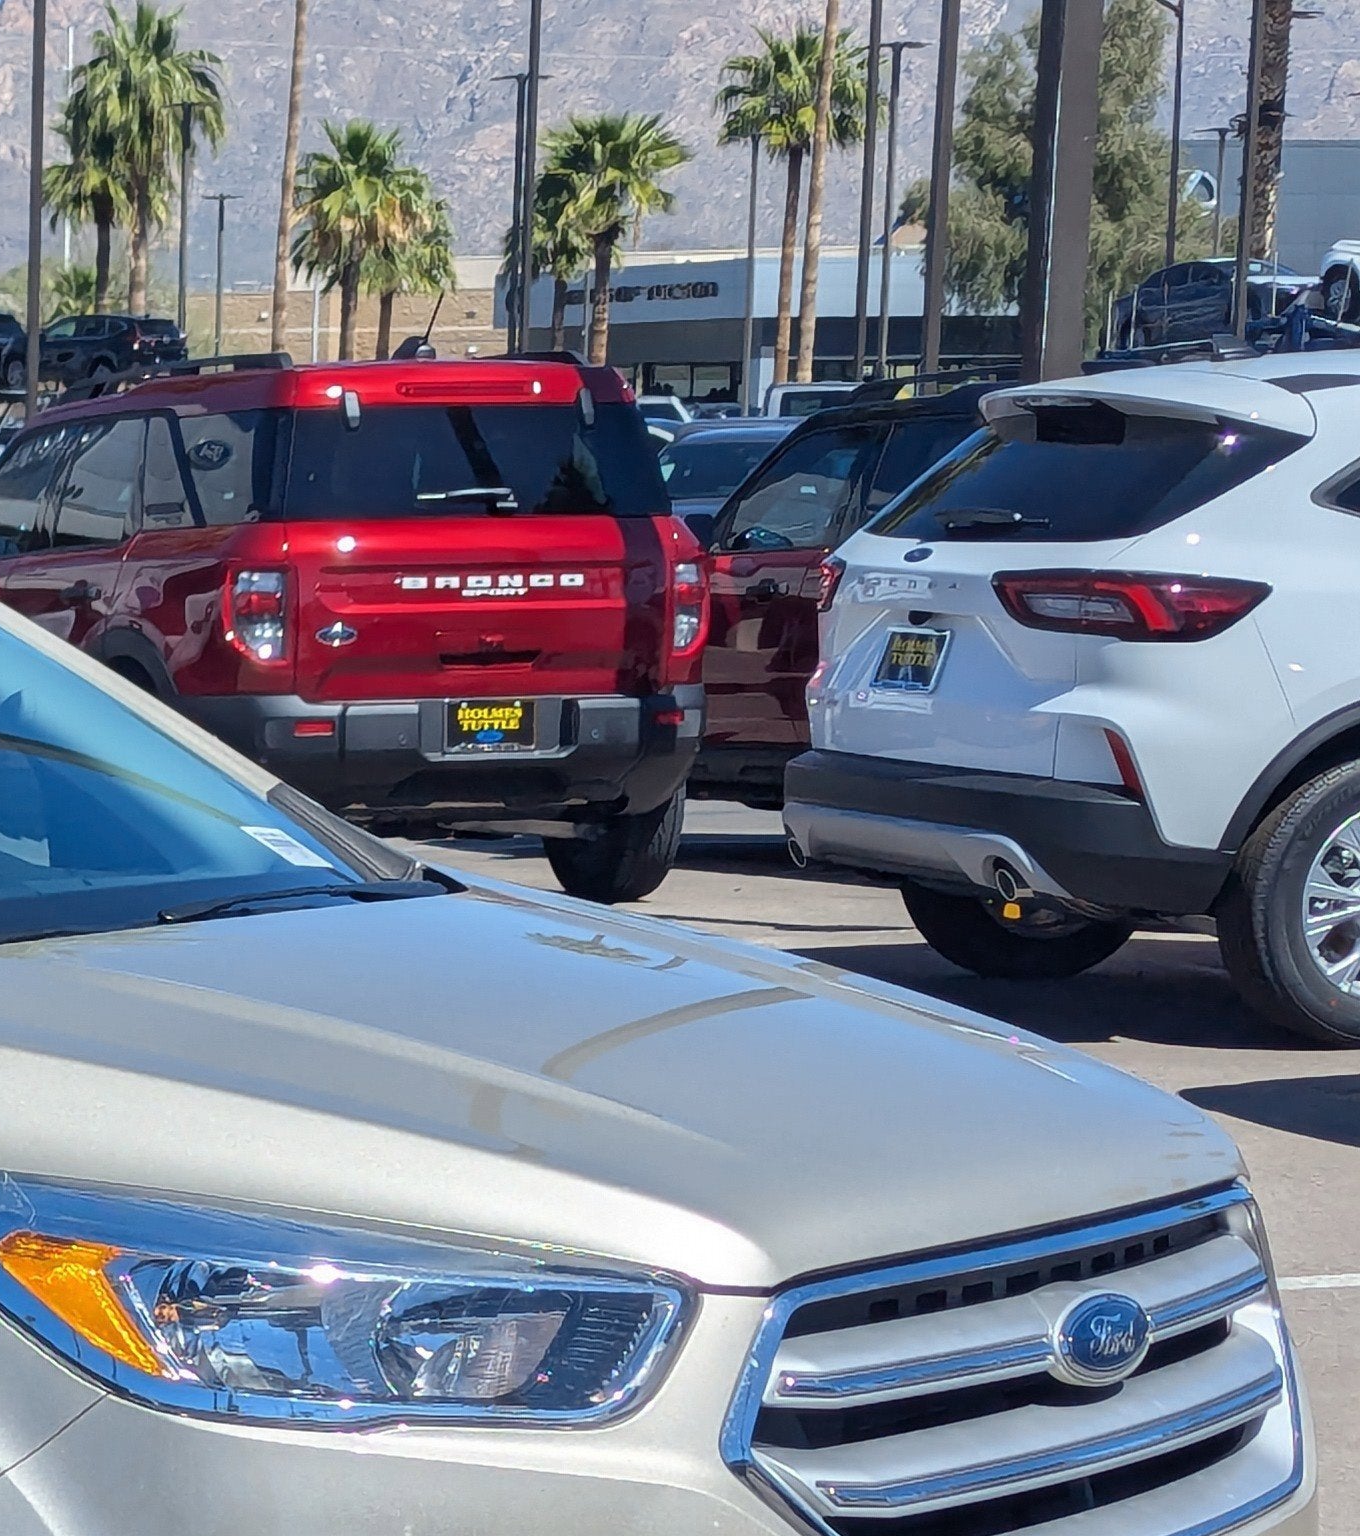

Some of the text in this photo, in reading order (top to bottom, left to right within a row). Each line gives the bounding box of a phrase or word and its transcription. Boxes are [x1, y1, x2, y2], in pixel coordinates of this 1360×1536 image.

[401, 573, 584, 590] BRONCO
[461, 588, 528, 597] SPORT
[457, 707, 523, 721] HOLMES
[459, 719, 520, 731] TUTTLE
[1089, 1313, 1136, 1361] Ford
